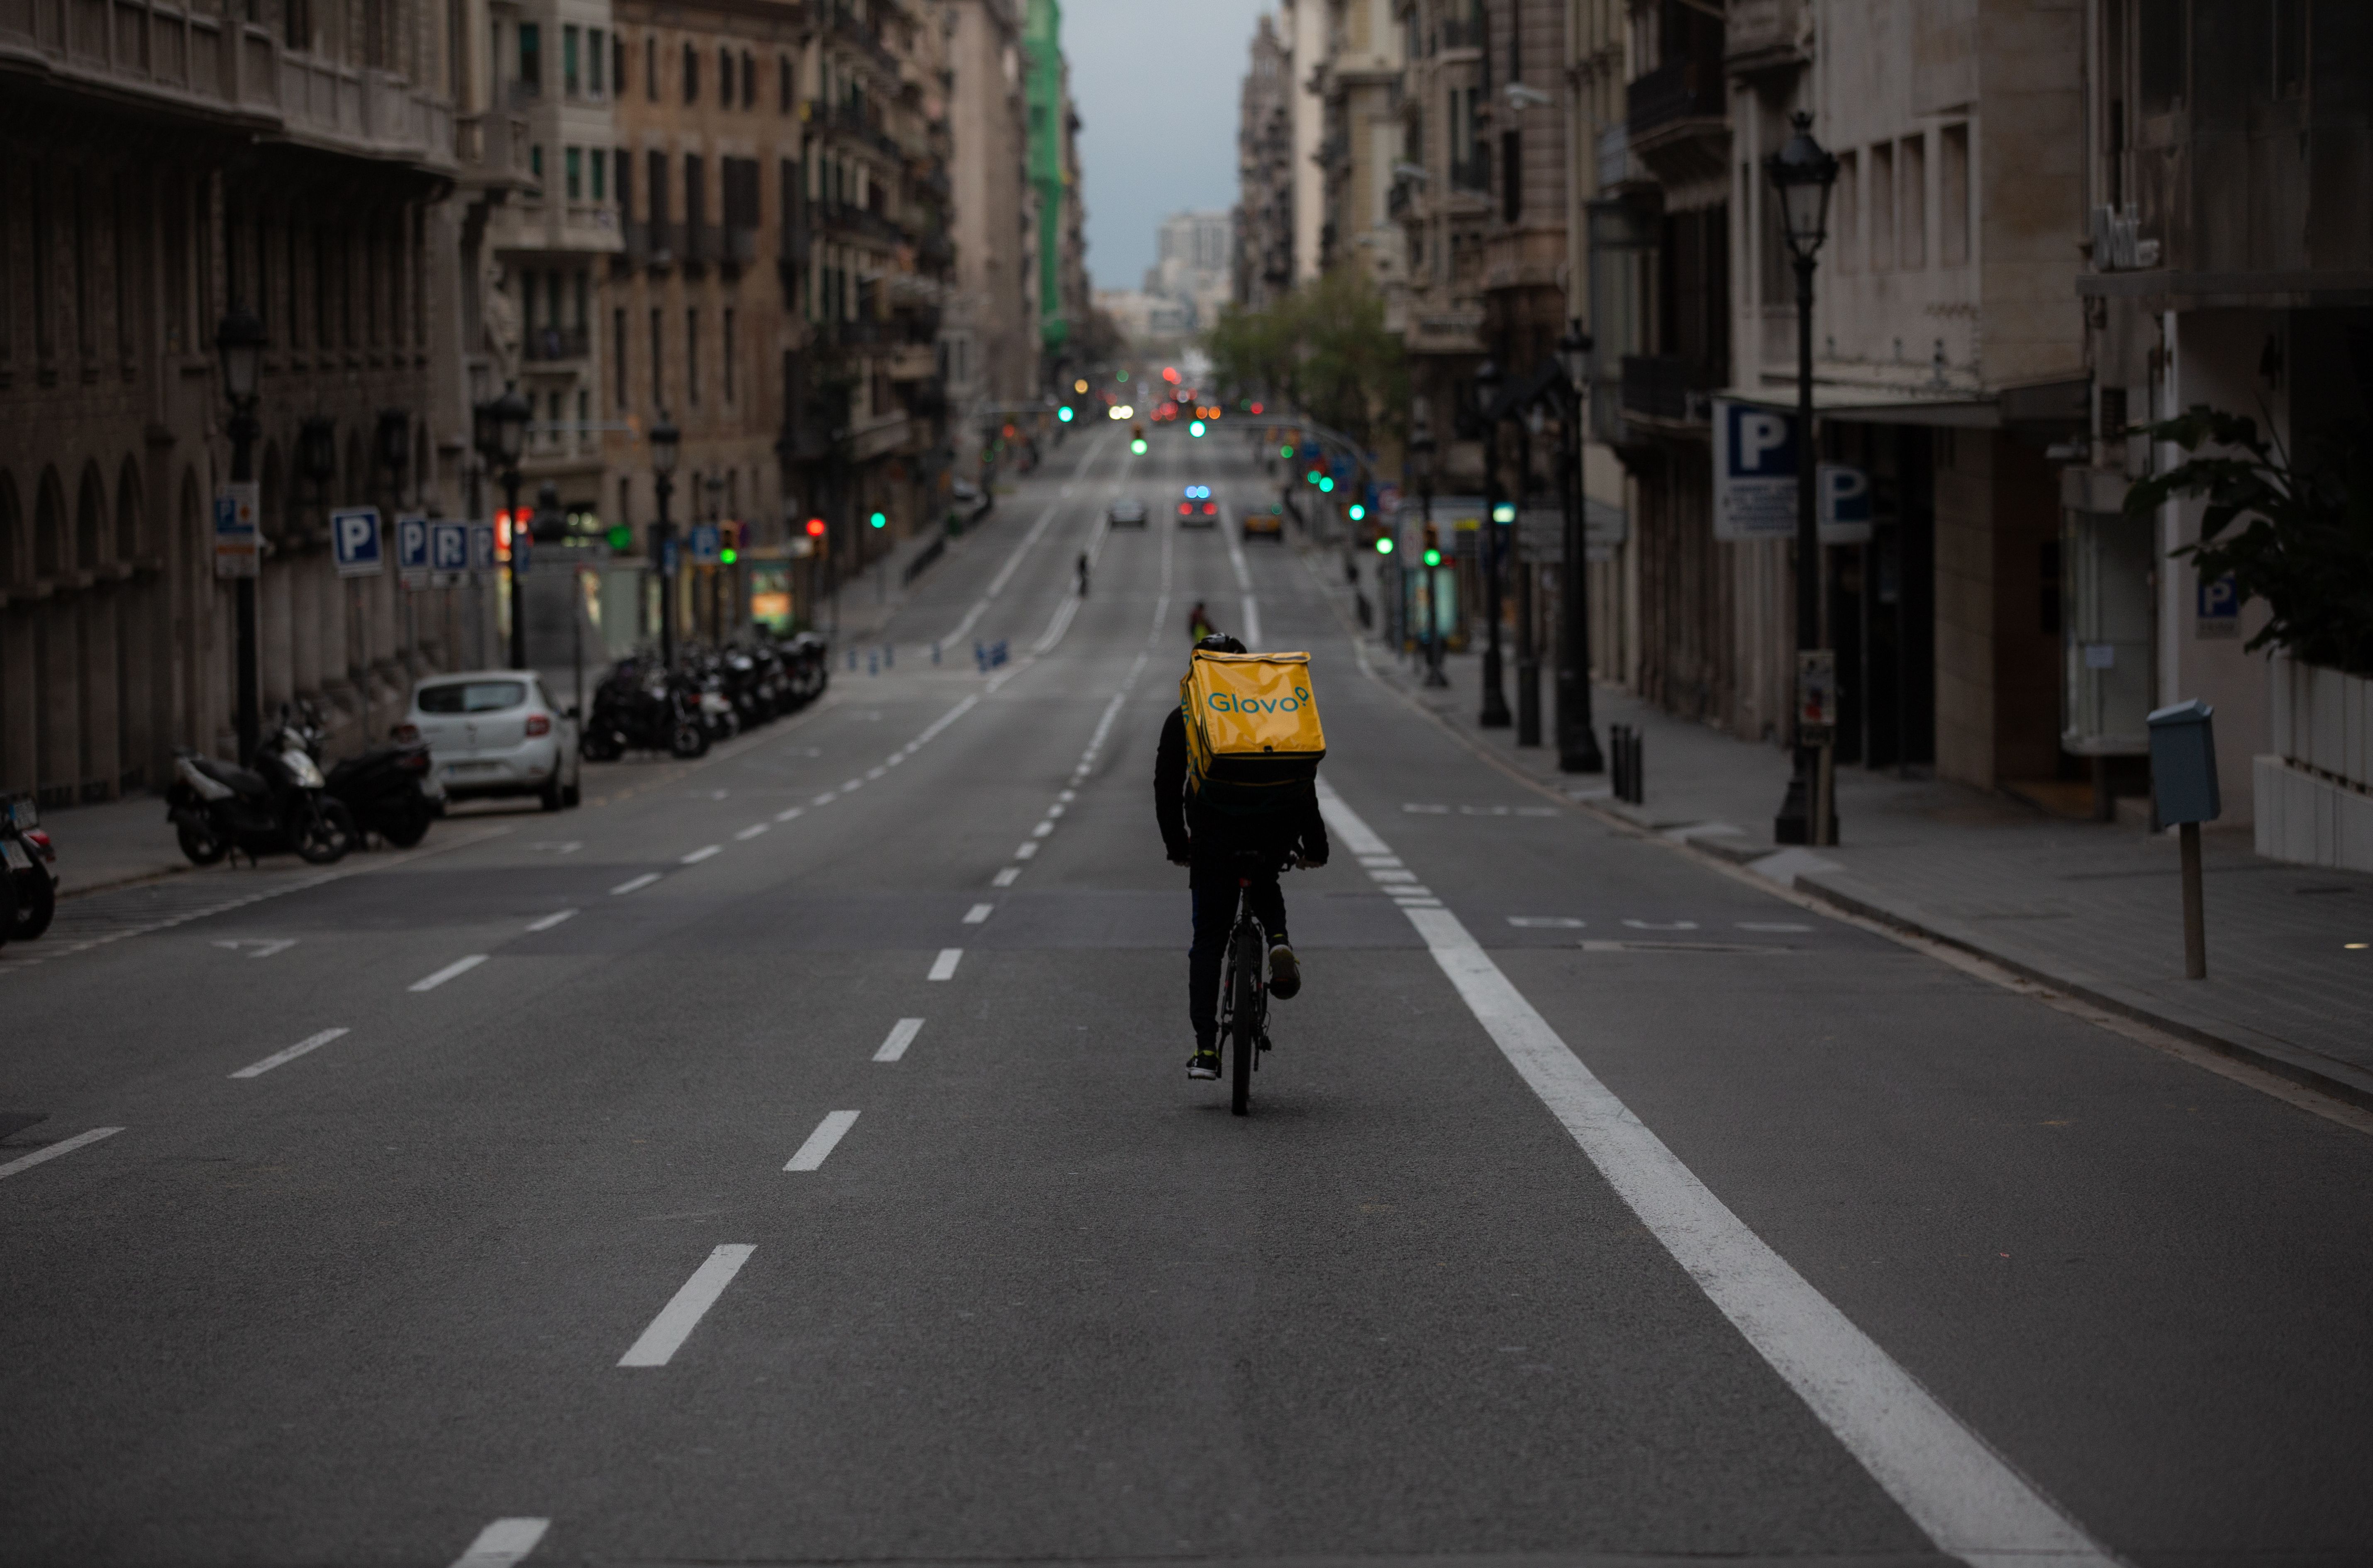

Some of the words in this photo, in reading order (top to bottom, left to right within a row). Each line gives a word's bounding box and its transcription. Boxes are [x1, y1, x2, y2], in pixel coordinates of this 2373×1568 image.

[1739, 412, 1787, 471] P
[1827, 468, 1868, 523] P
[340, 518, 371, 561] P
[404, 524, 423, 563] P
[2205, 582, 2231, 612] P
[1208, 692, 1299, 714] Glovo
